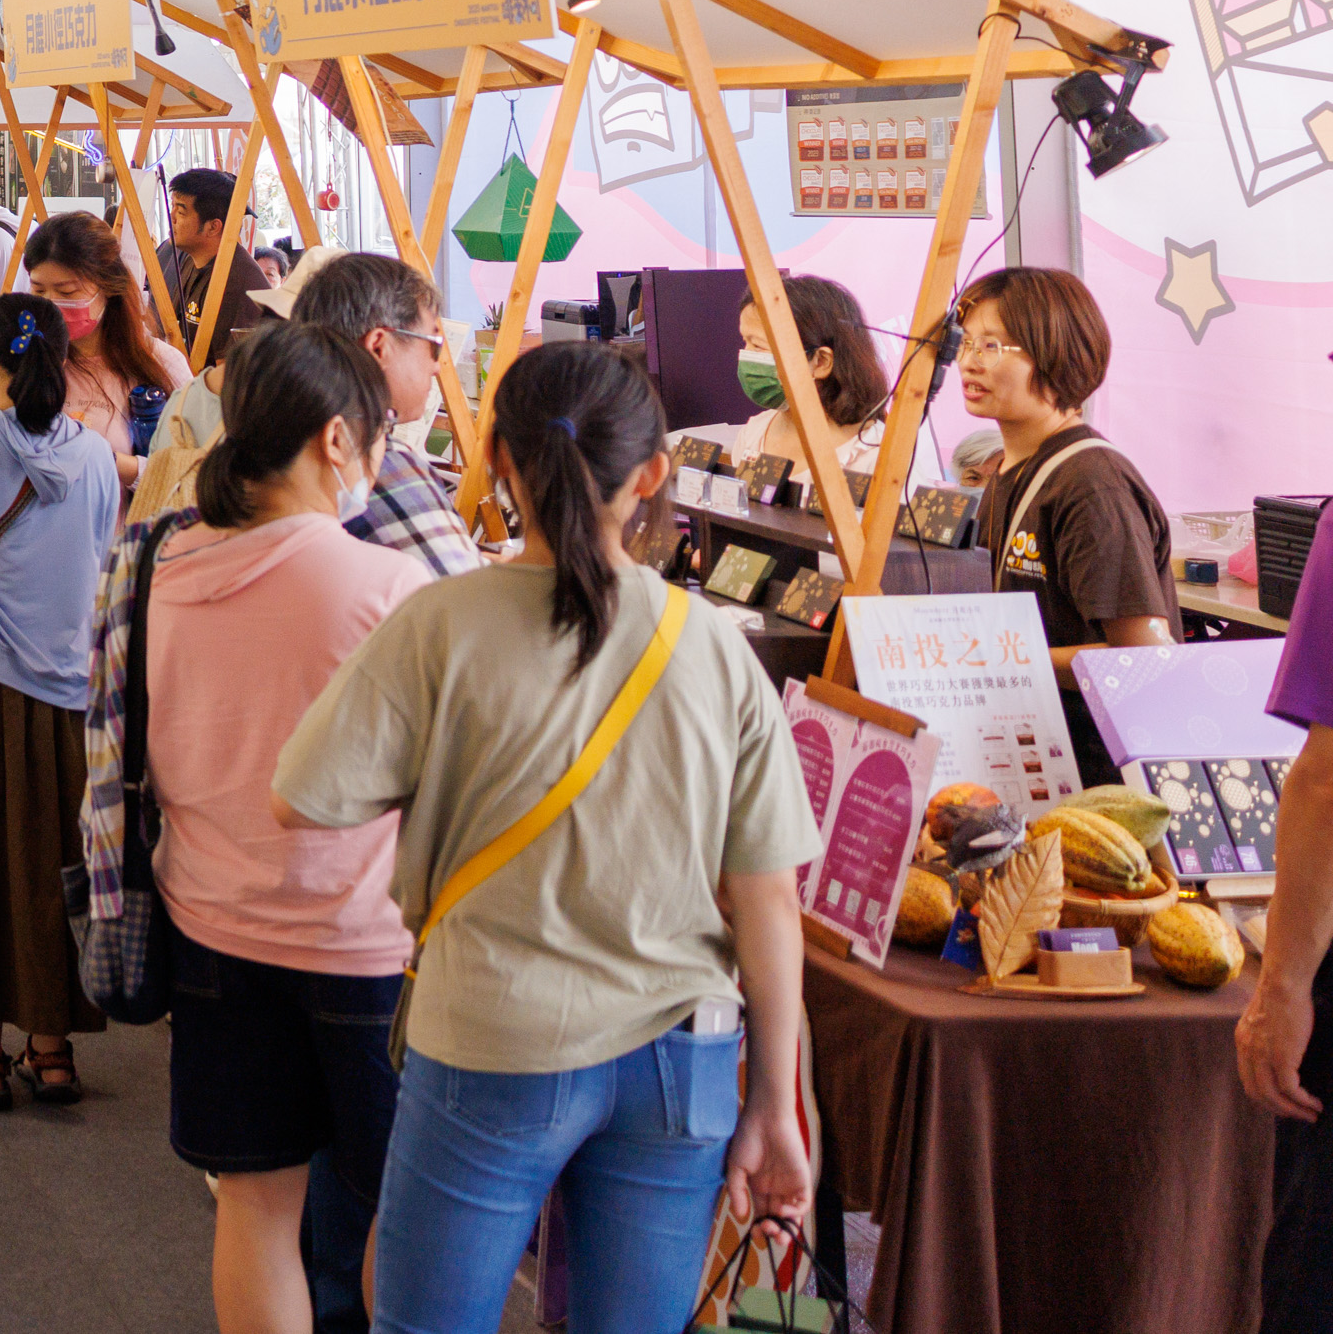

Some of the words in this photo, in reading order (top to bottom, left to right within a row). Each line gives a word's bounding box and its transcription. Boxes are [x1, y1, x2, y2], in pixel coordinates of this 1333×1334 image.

[25, 2, 97, 55] 月鹿小徑巧克力
[872, 629, 1032, 670] 南投之光
[886, 675, 1033, 693] 世界巧克力大賽獲獎最多的
